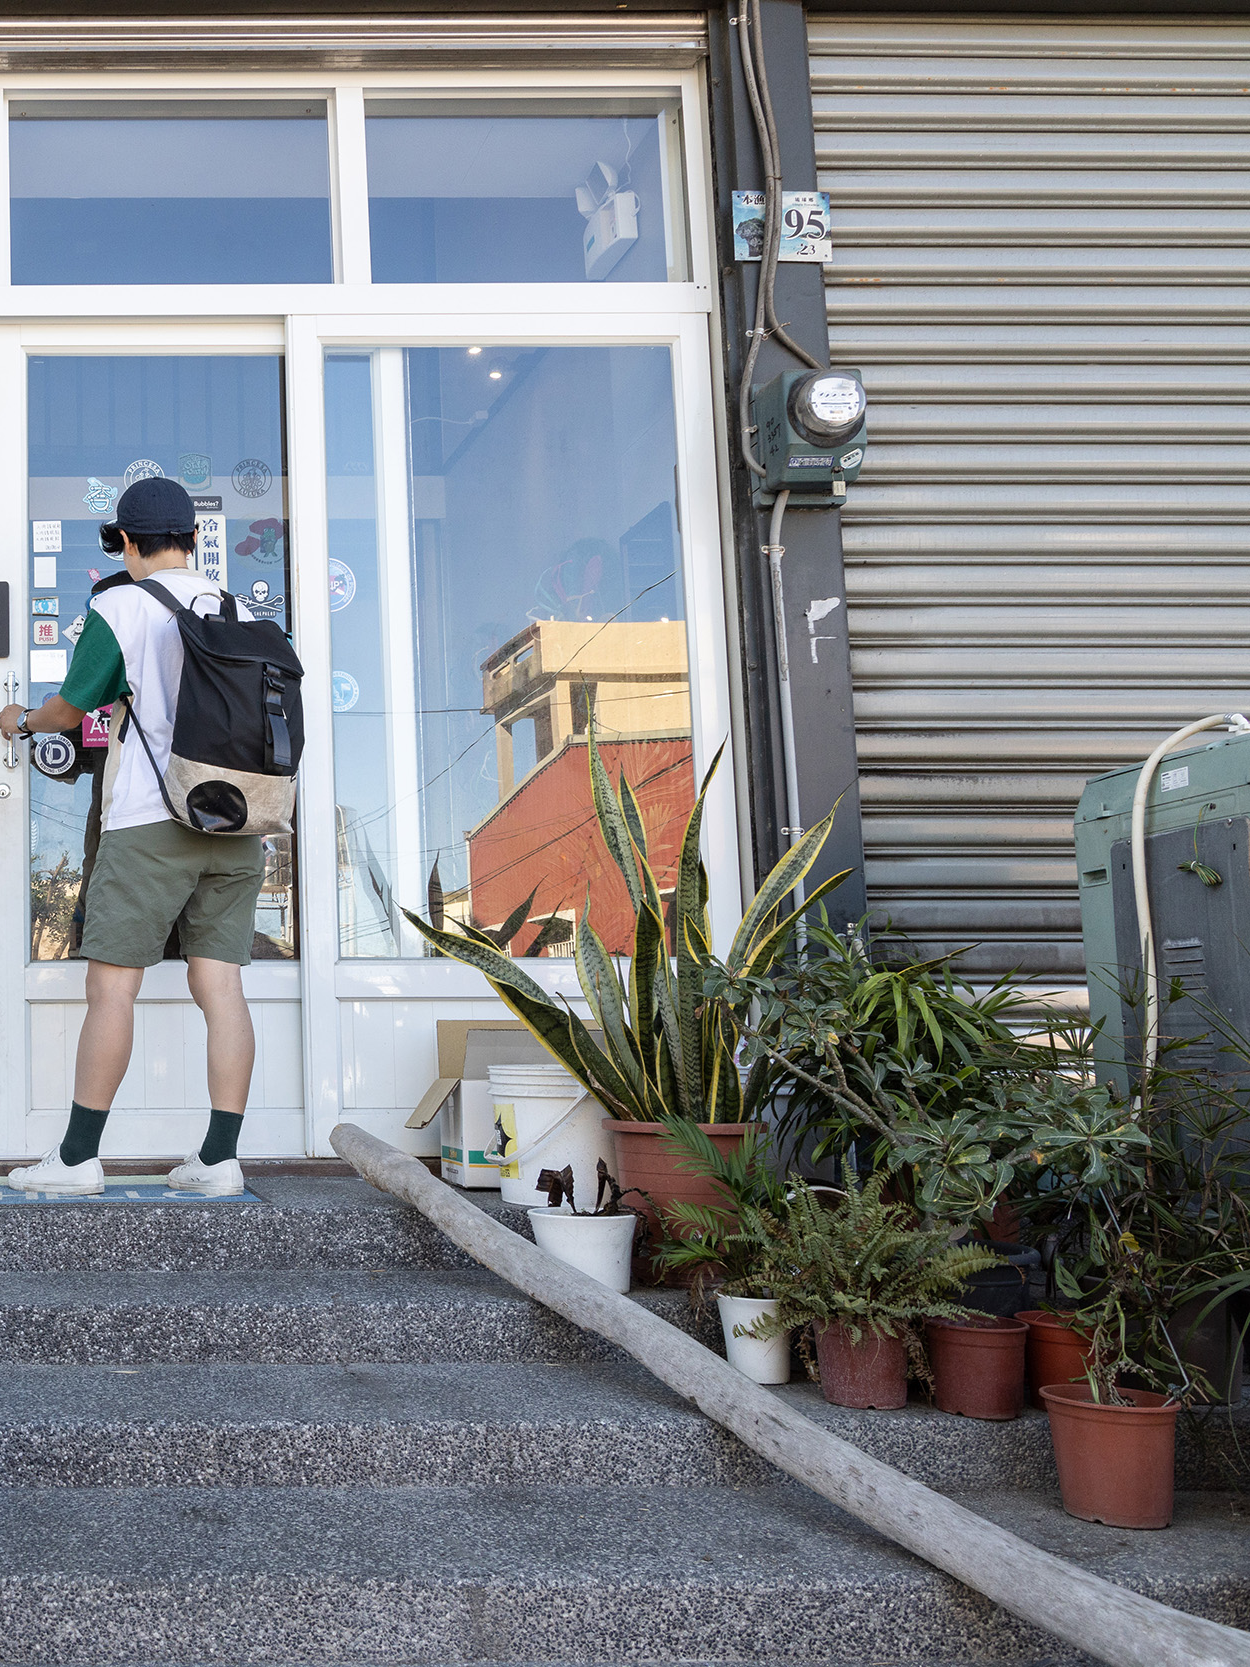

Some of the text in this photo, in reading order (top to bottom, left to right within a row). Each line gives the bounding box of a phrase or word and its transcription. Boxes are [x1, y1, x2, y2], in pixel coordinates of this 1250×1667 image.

[784, 208, 826, 241] 95
[202, 518, 221, 582] 冷氣開放
[38, 623, 54, 637] 推
